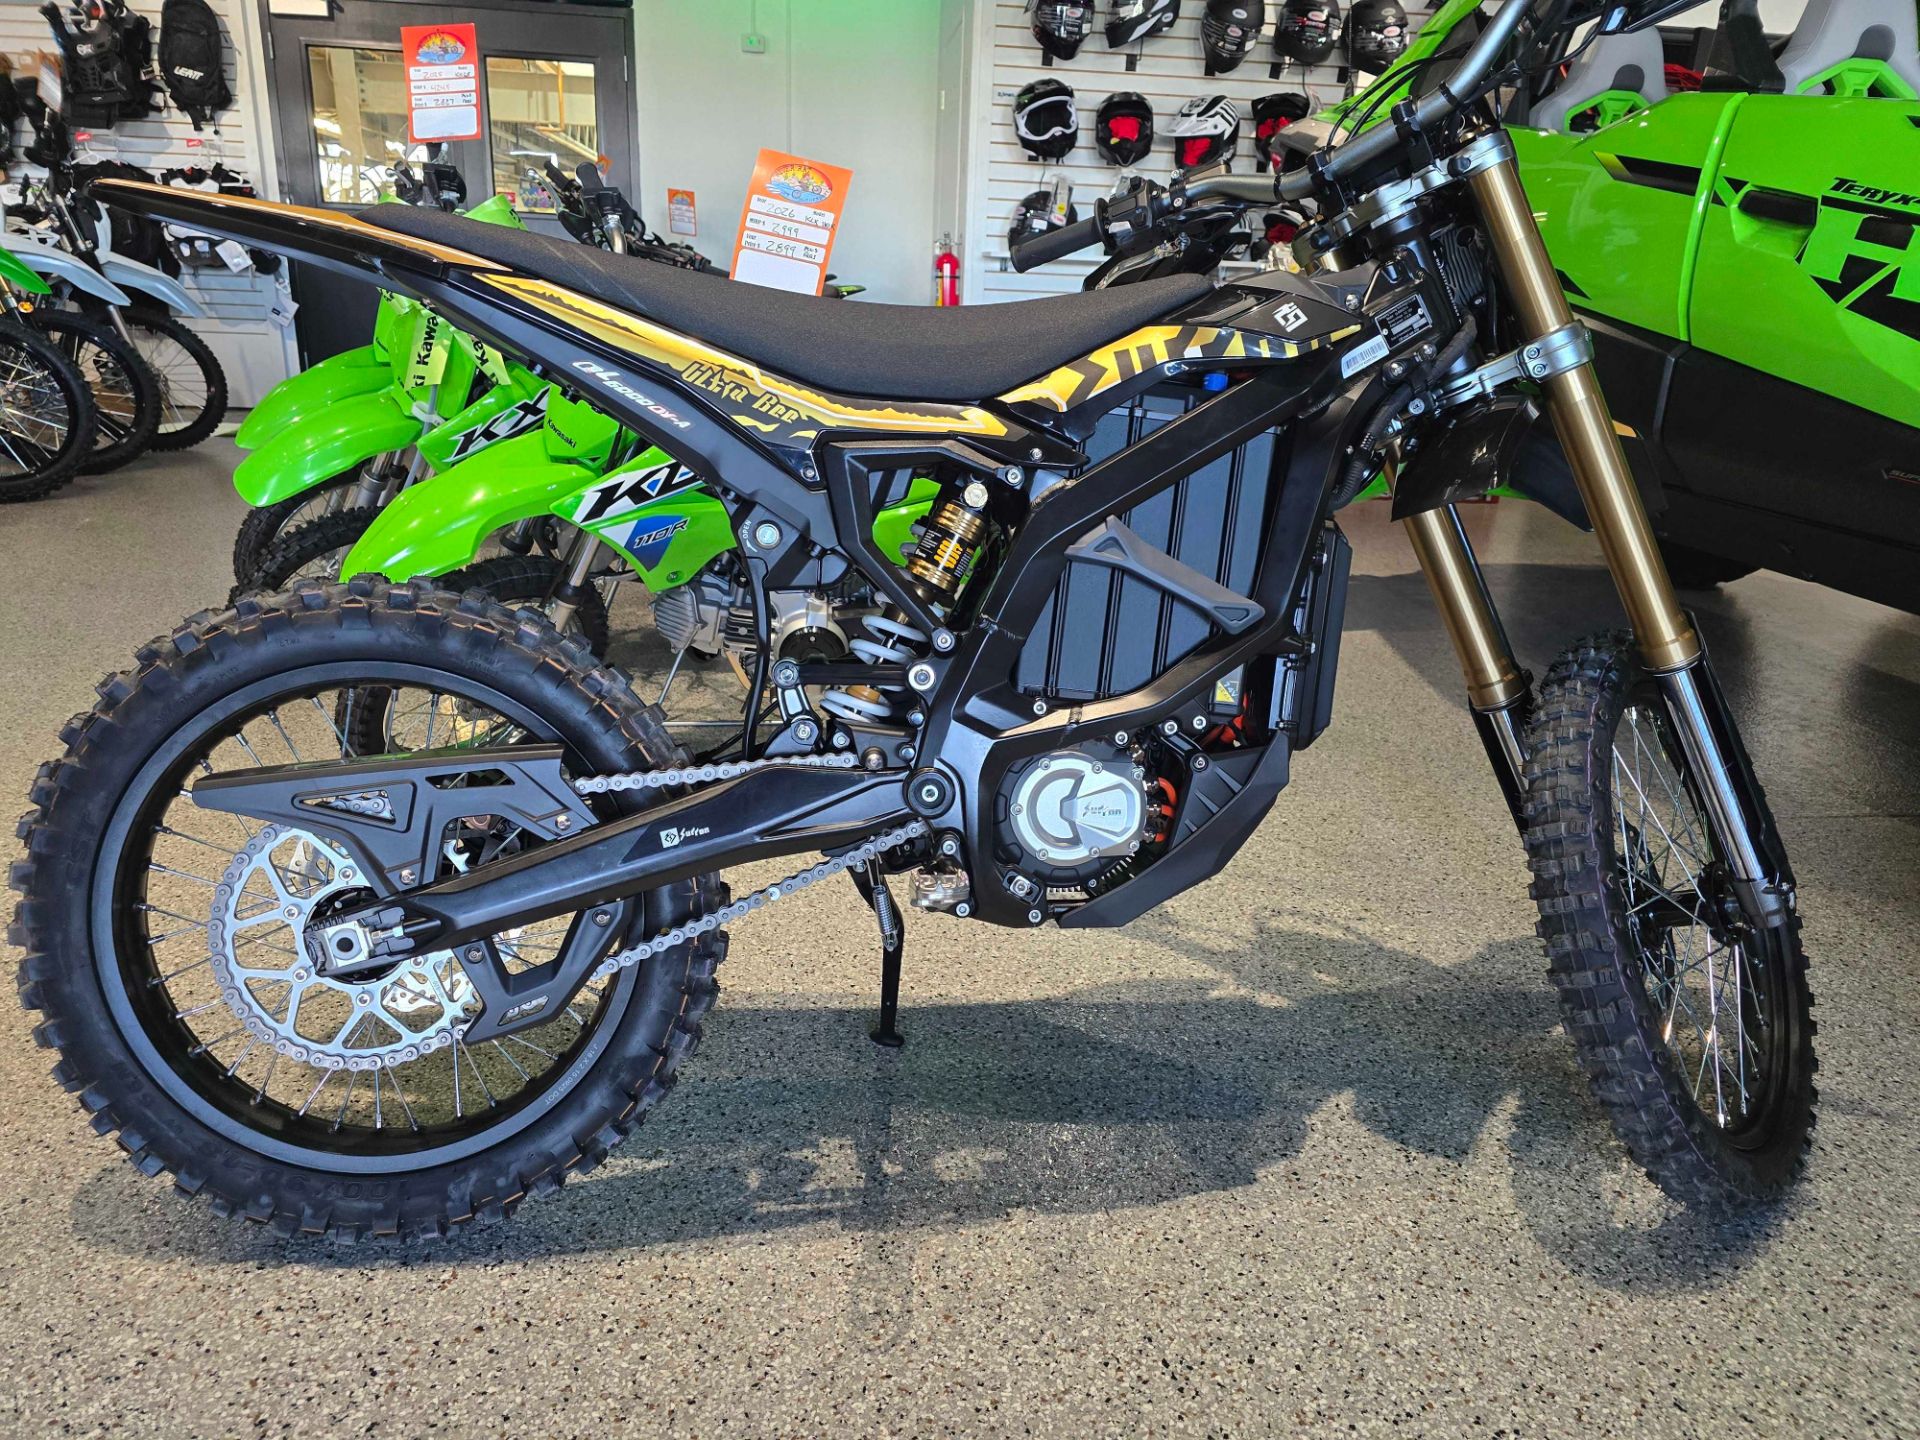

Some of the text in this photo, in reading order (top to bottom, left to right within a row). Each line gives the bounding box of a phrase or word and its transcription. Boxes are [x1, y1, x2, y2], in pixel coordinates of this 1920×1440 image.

[173, 65, 205, 80] LEATT
[766, 203, 796, 218] 2026
[771, 222, 800, 238] 2999
[765, 240, 797, 259] 2899
[752, 391, 804, 425] Bee
[547, 418, 577, 449] Kawasaki
[633, 518, 690, 549] 110R
[742, 519, 752, 539] OPEN
